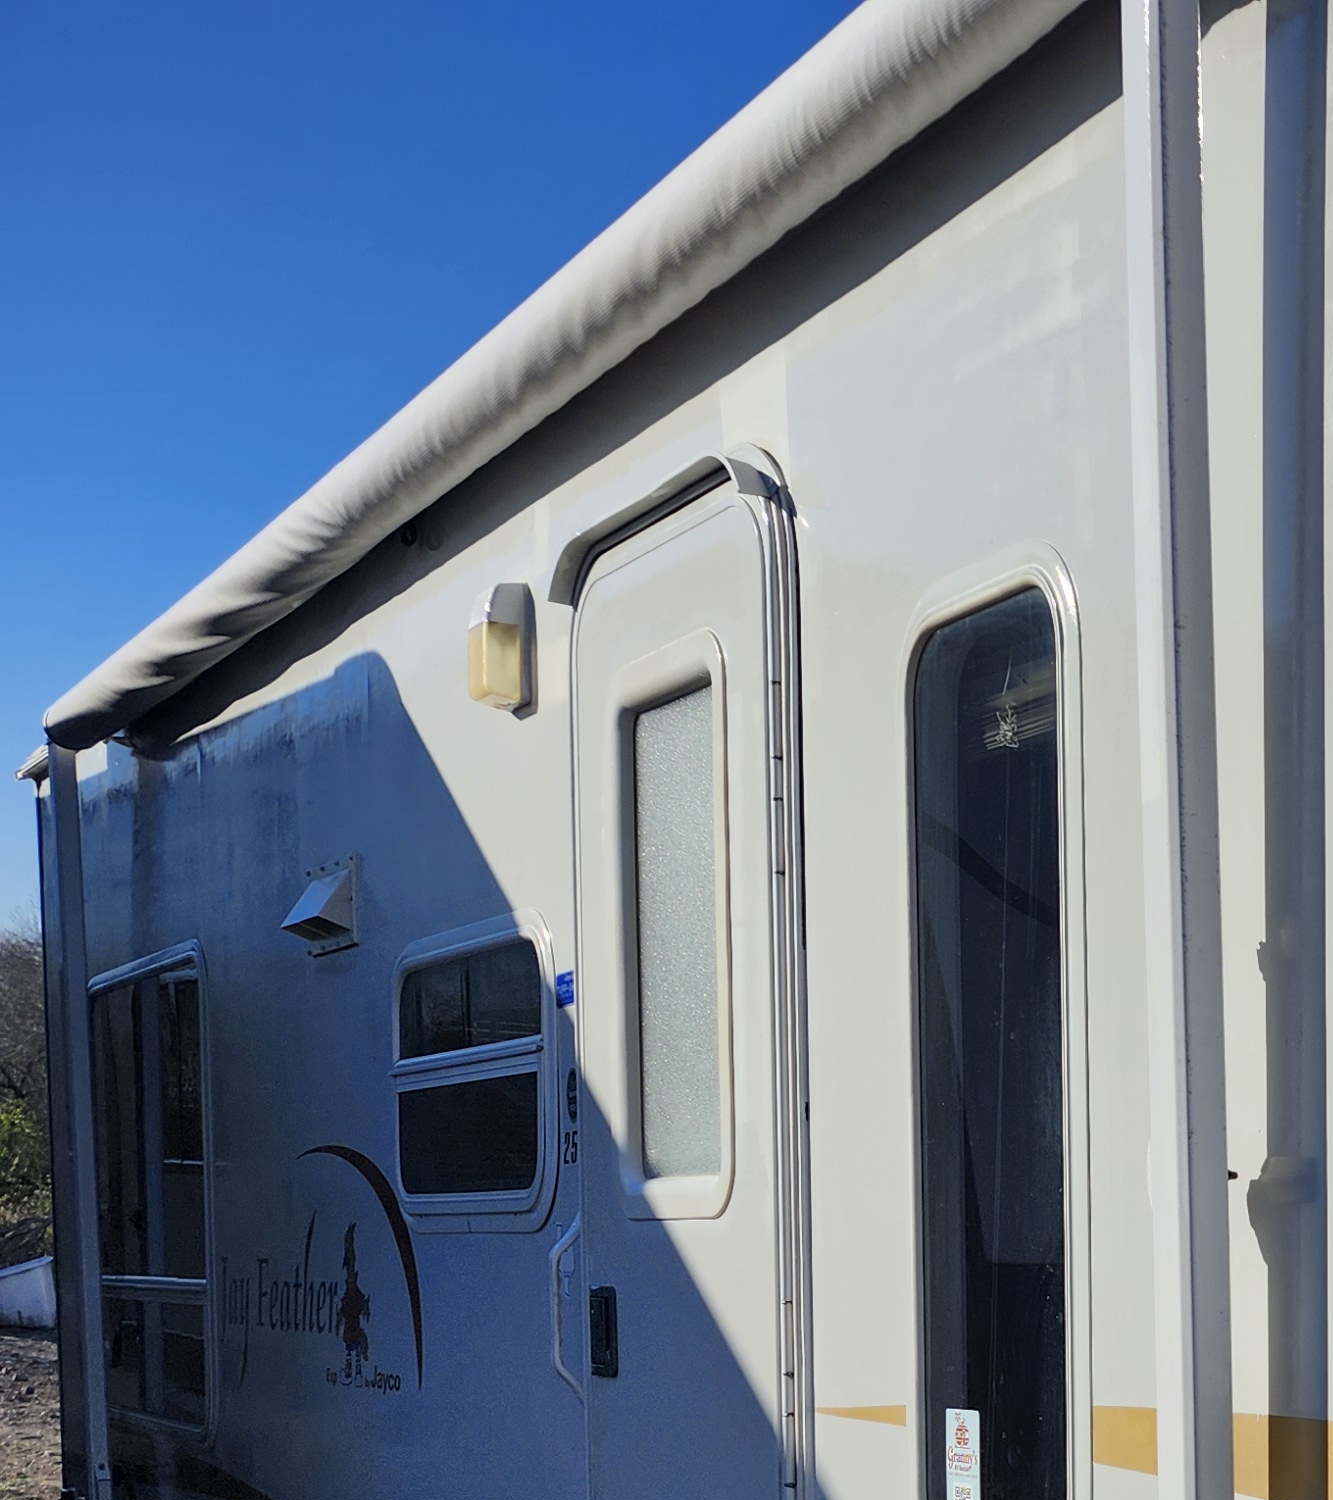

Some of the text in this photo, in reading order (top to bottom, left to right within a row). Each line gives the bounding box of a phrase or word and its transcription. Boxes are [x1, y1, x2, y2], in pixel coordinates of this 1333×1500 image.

[563, 1130, 578, 1165] 25
[220, 1209, 338, 1391] Jay Feather
[371, 1365, 401, 1395] Jayco
